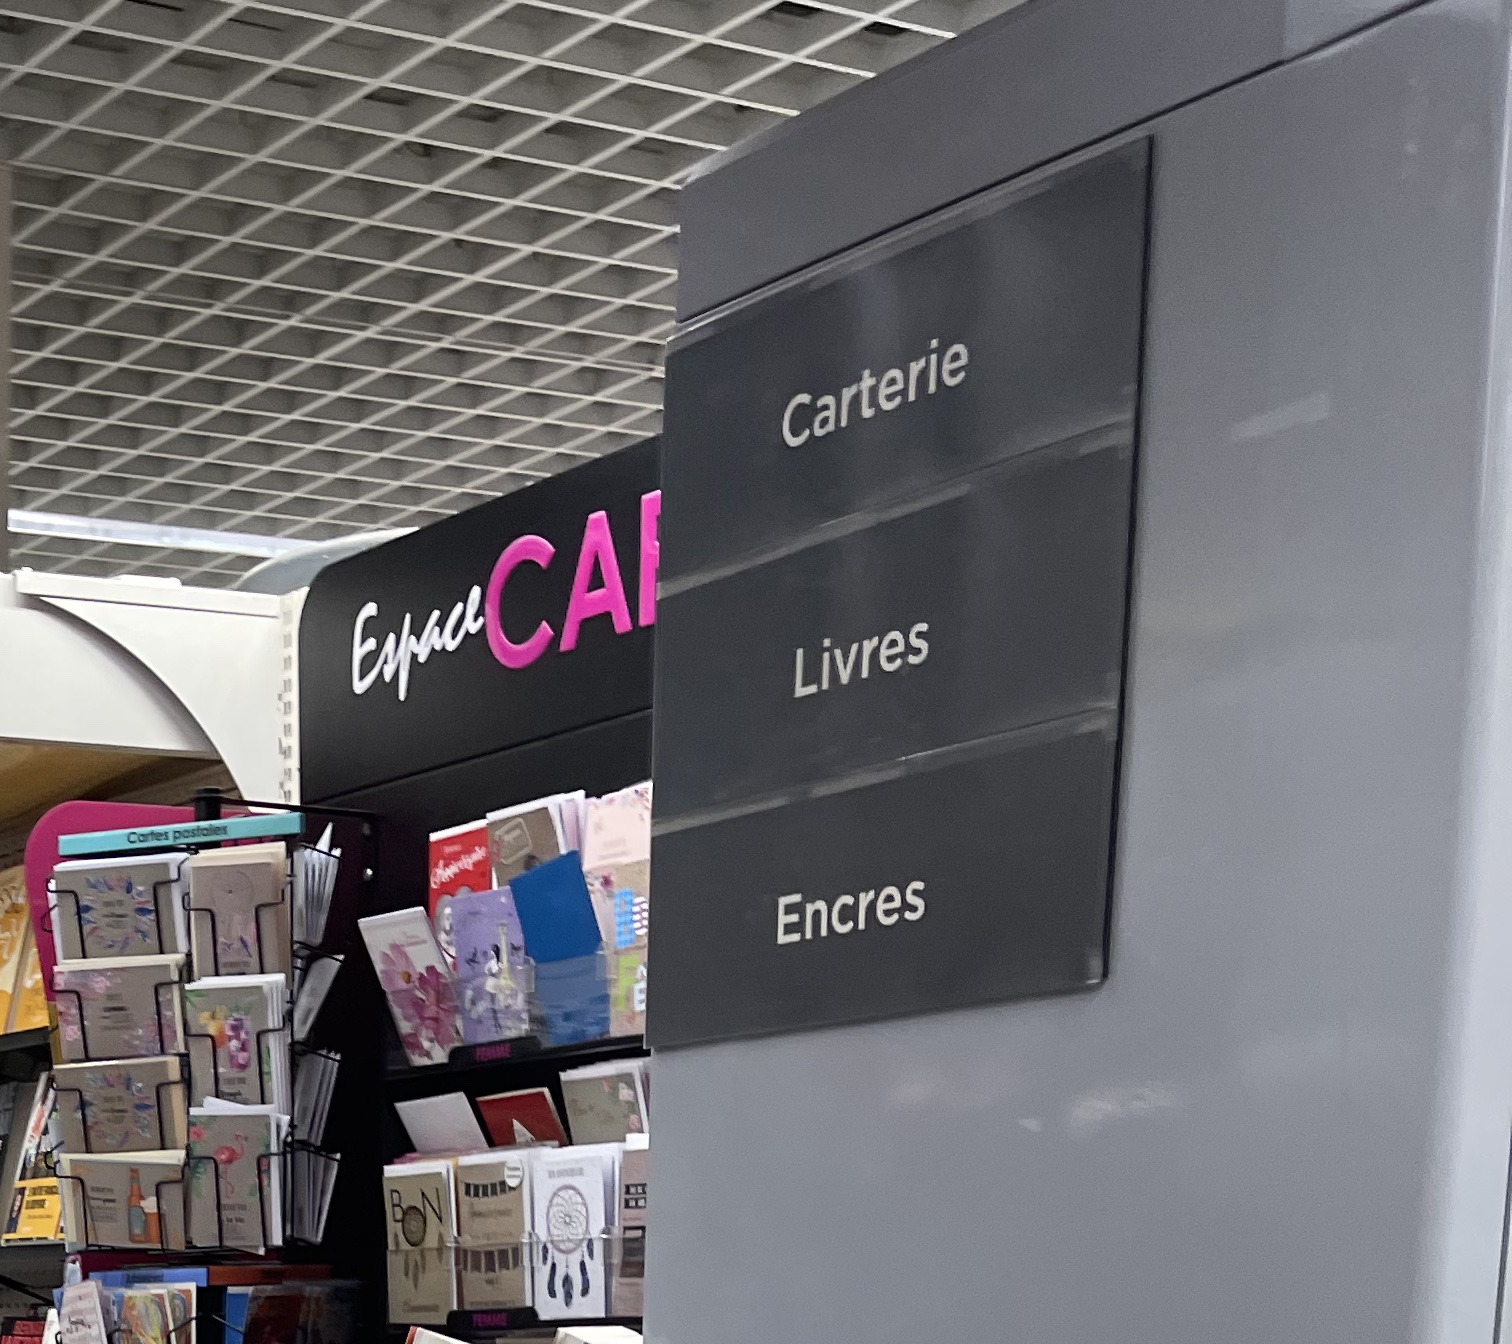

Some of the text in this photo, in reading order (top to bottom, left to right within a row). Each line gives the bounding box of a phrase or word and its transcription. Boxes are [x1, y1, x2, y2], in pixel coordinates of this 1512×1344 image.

[782, 338, 970, 448] Carterie
[351, 586, 486, 702] Espace
[793, 620, 931, 699] Livres
[127, 824, 228, 844] Cartes postales
[775, 878, 927, 946] Encres
